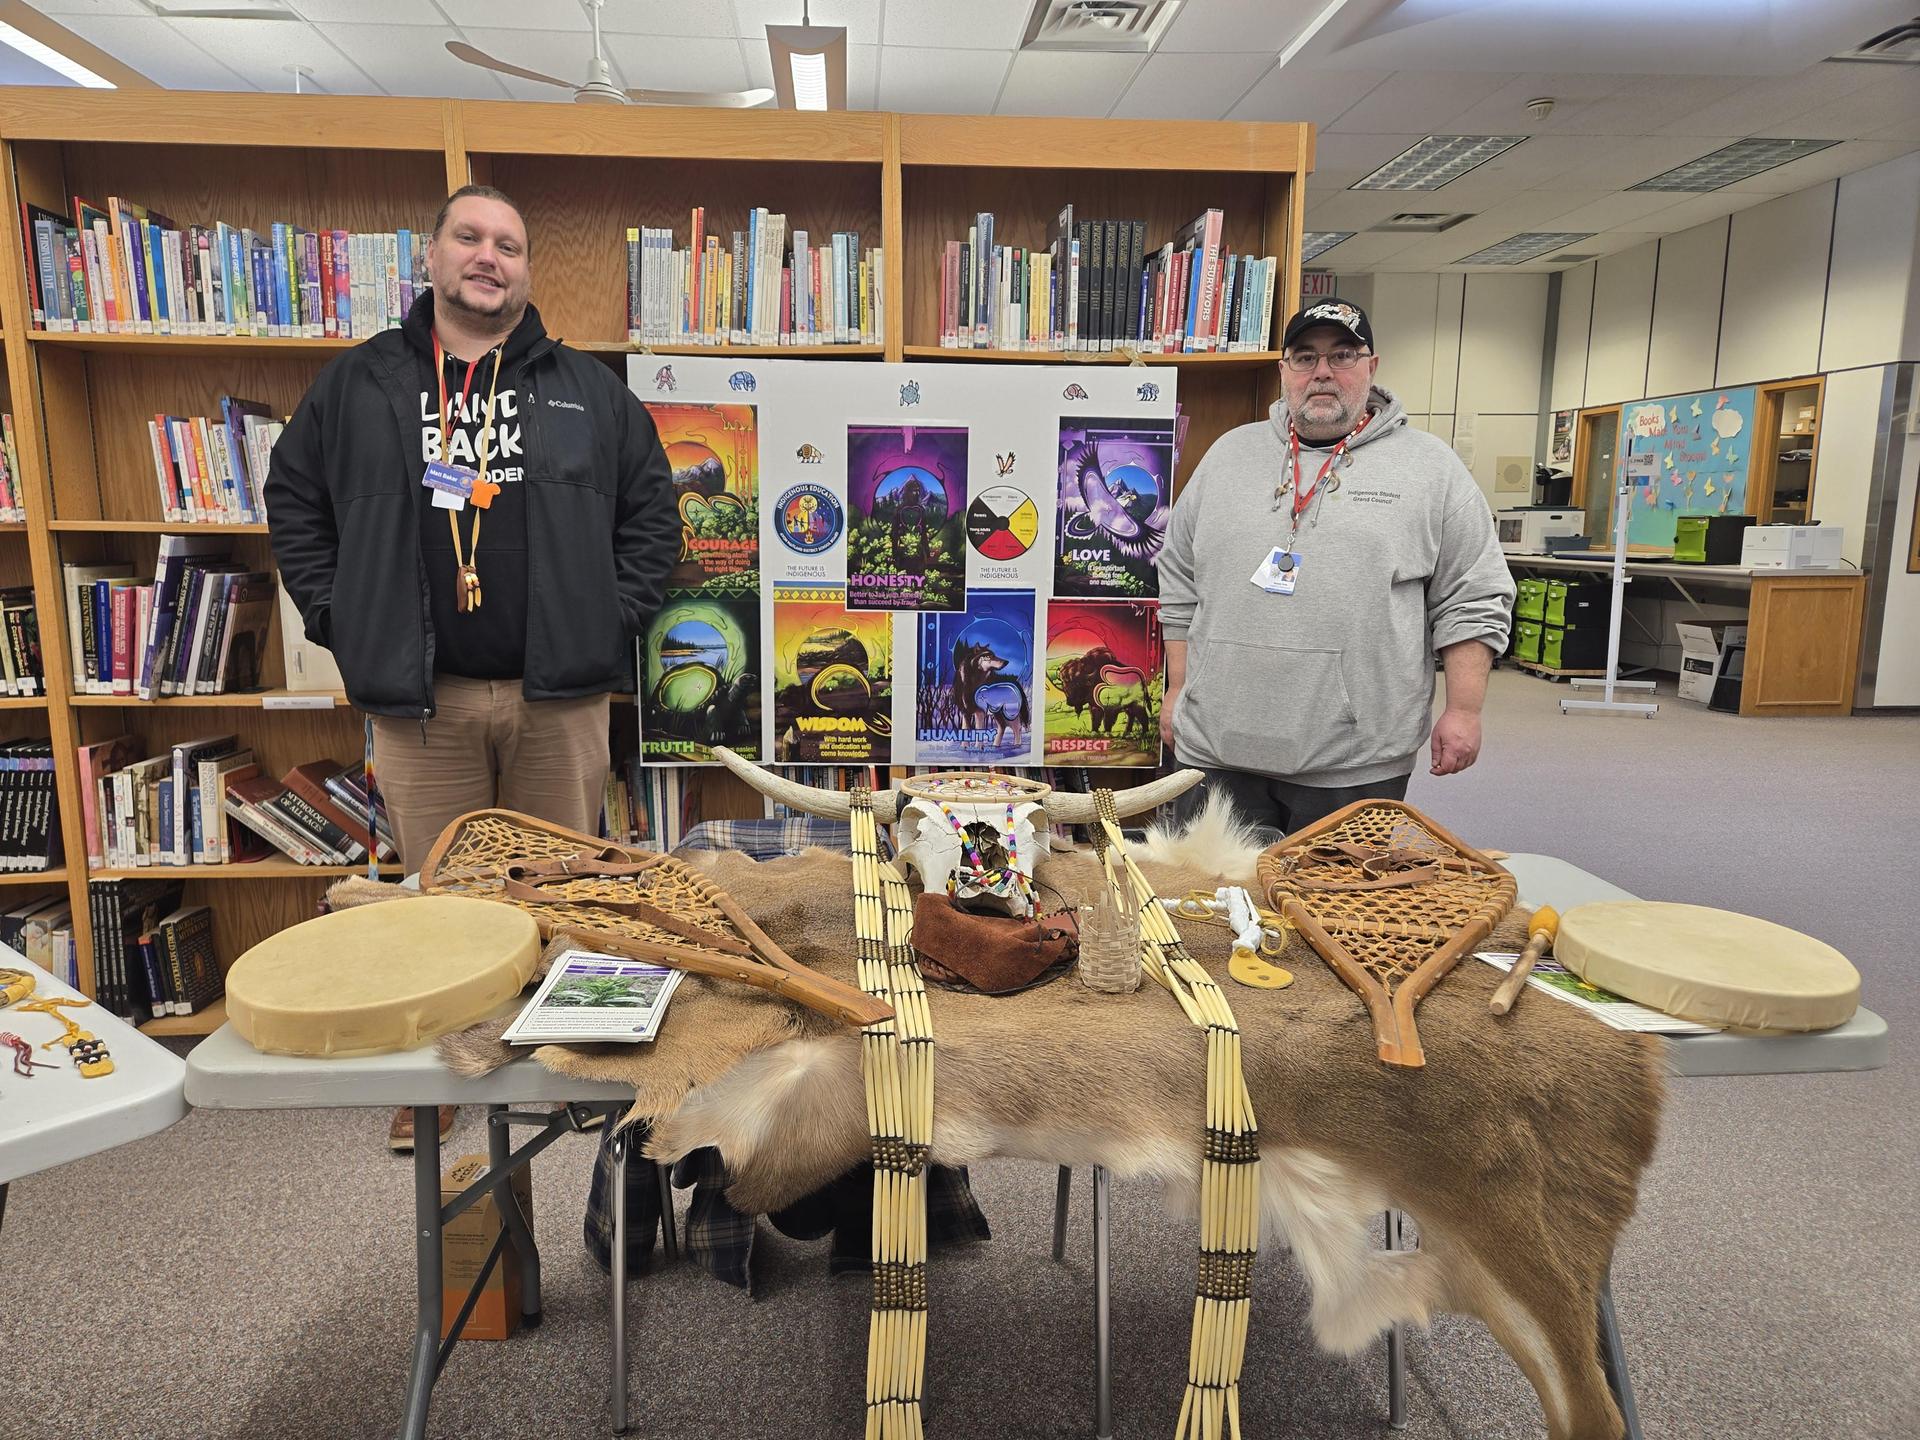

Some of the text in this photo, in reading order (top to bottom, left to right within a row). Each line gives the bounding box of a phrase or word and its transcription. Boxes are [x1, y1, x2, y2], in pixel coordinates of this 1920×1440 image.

[40, 231, 53, 274] PERSONALITY
[229, 234, 242, 287] DARING GREATLY
[755, 245, 763, 269] Mythology
[43, 274, 55, 290] TYPE
[731, 258, 739, 288] AMERICA
[1203, 242, 1218, 321] THE SURVIVORS
[1245, 268, 1253, 290] INVISIBLE
[1262, 272, 1274, 318] BRAIDING SWEETGRASS
[1302, 274, 1334, 296] EXIT
[1146, 303, 1154, 323] MAASAI
[1233, 303, 1241, 323] MAASAI
[555, 400, 586, 412] Columbia
[1639, 416, 1660, 428] Books
[214, 427, 226, 446] Teen
[422, 424, 524, 462] BACK
[429, 469, 458, 482] Matt Baker
[777, 485, 840, 510] INDIGENOUS EDUCATION
[1379, 491, 1402, 500] Student
[687, 540, 758, 550] COURAGE
[1072, 549, 1112, 562] LOVE
[714, 566, 728, 574] right
[734, 559, 752, 568] doing
[181, 569, 191, 590] MAGIC
[851, 575, 926, 588] HONESTY
[176, 589, 188, 617] SYMBOLS
[81, 586, 91, 651] WESTERN PHILOSOPHY
[795, 717, 868, 732] WISDOM
[920, 729, 998, 742] HUMILITY
[1051, 740, 1110, 752] RESPECT
[642, 741, 696, 754] TRUTH
[735, 746, 758, 754] easiest
[16, 791, 24, 810] Thinking
[286, 791, 330, 826] MYTHOLOGY
[286, 791, 330, 826] MYTHOLOGY
[21, 791, 34, 846] Developmental Psychology
[32, 803, 42, 828] Psychology
[41, 790, 52, 836] Abnormal Psychology
[280, 796, 324, 833] OF ALL RACES
[12, 820, 22, 840] Knowing
[175, 803, 183, 847] SAINTS
[164, 926, 184, 992] WORLD MYTHOLOGY
